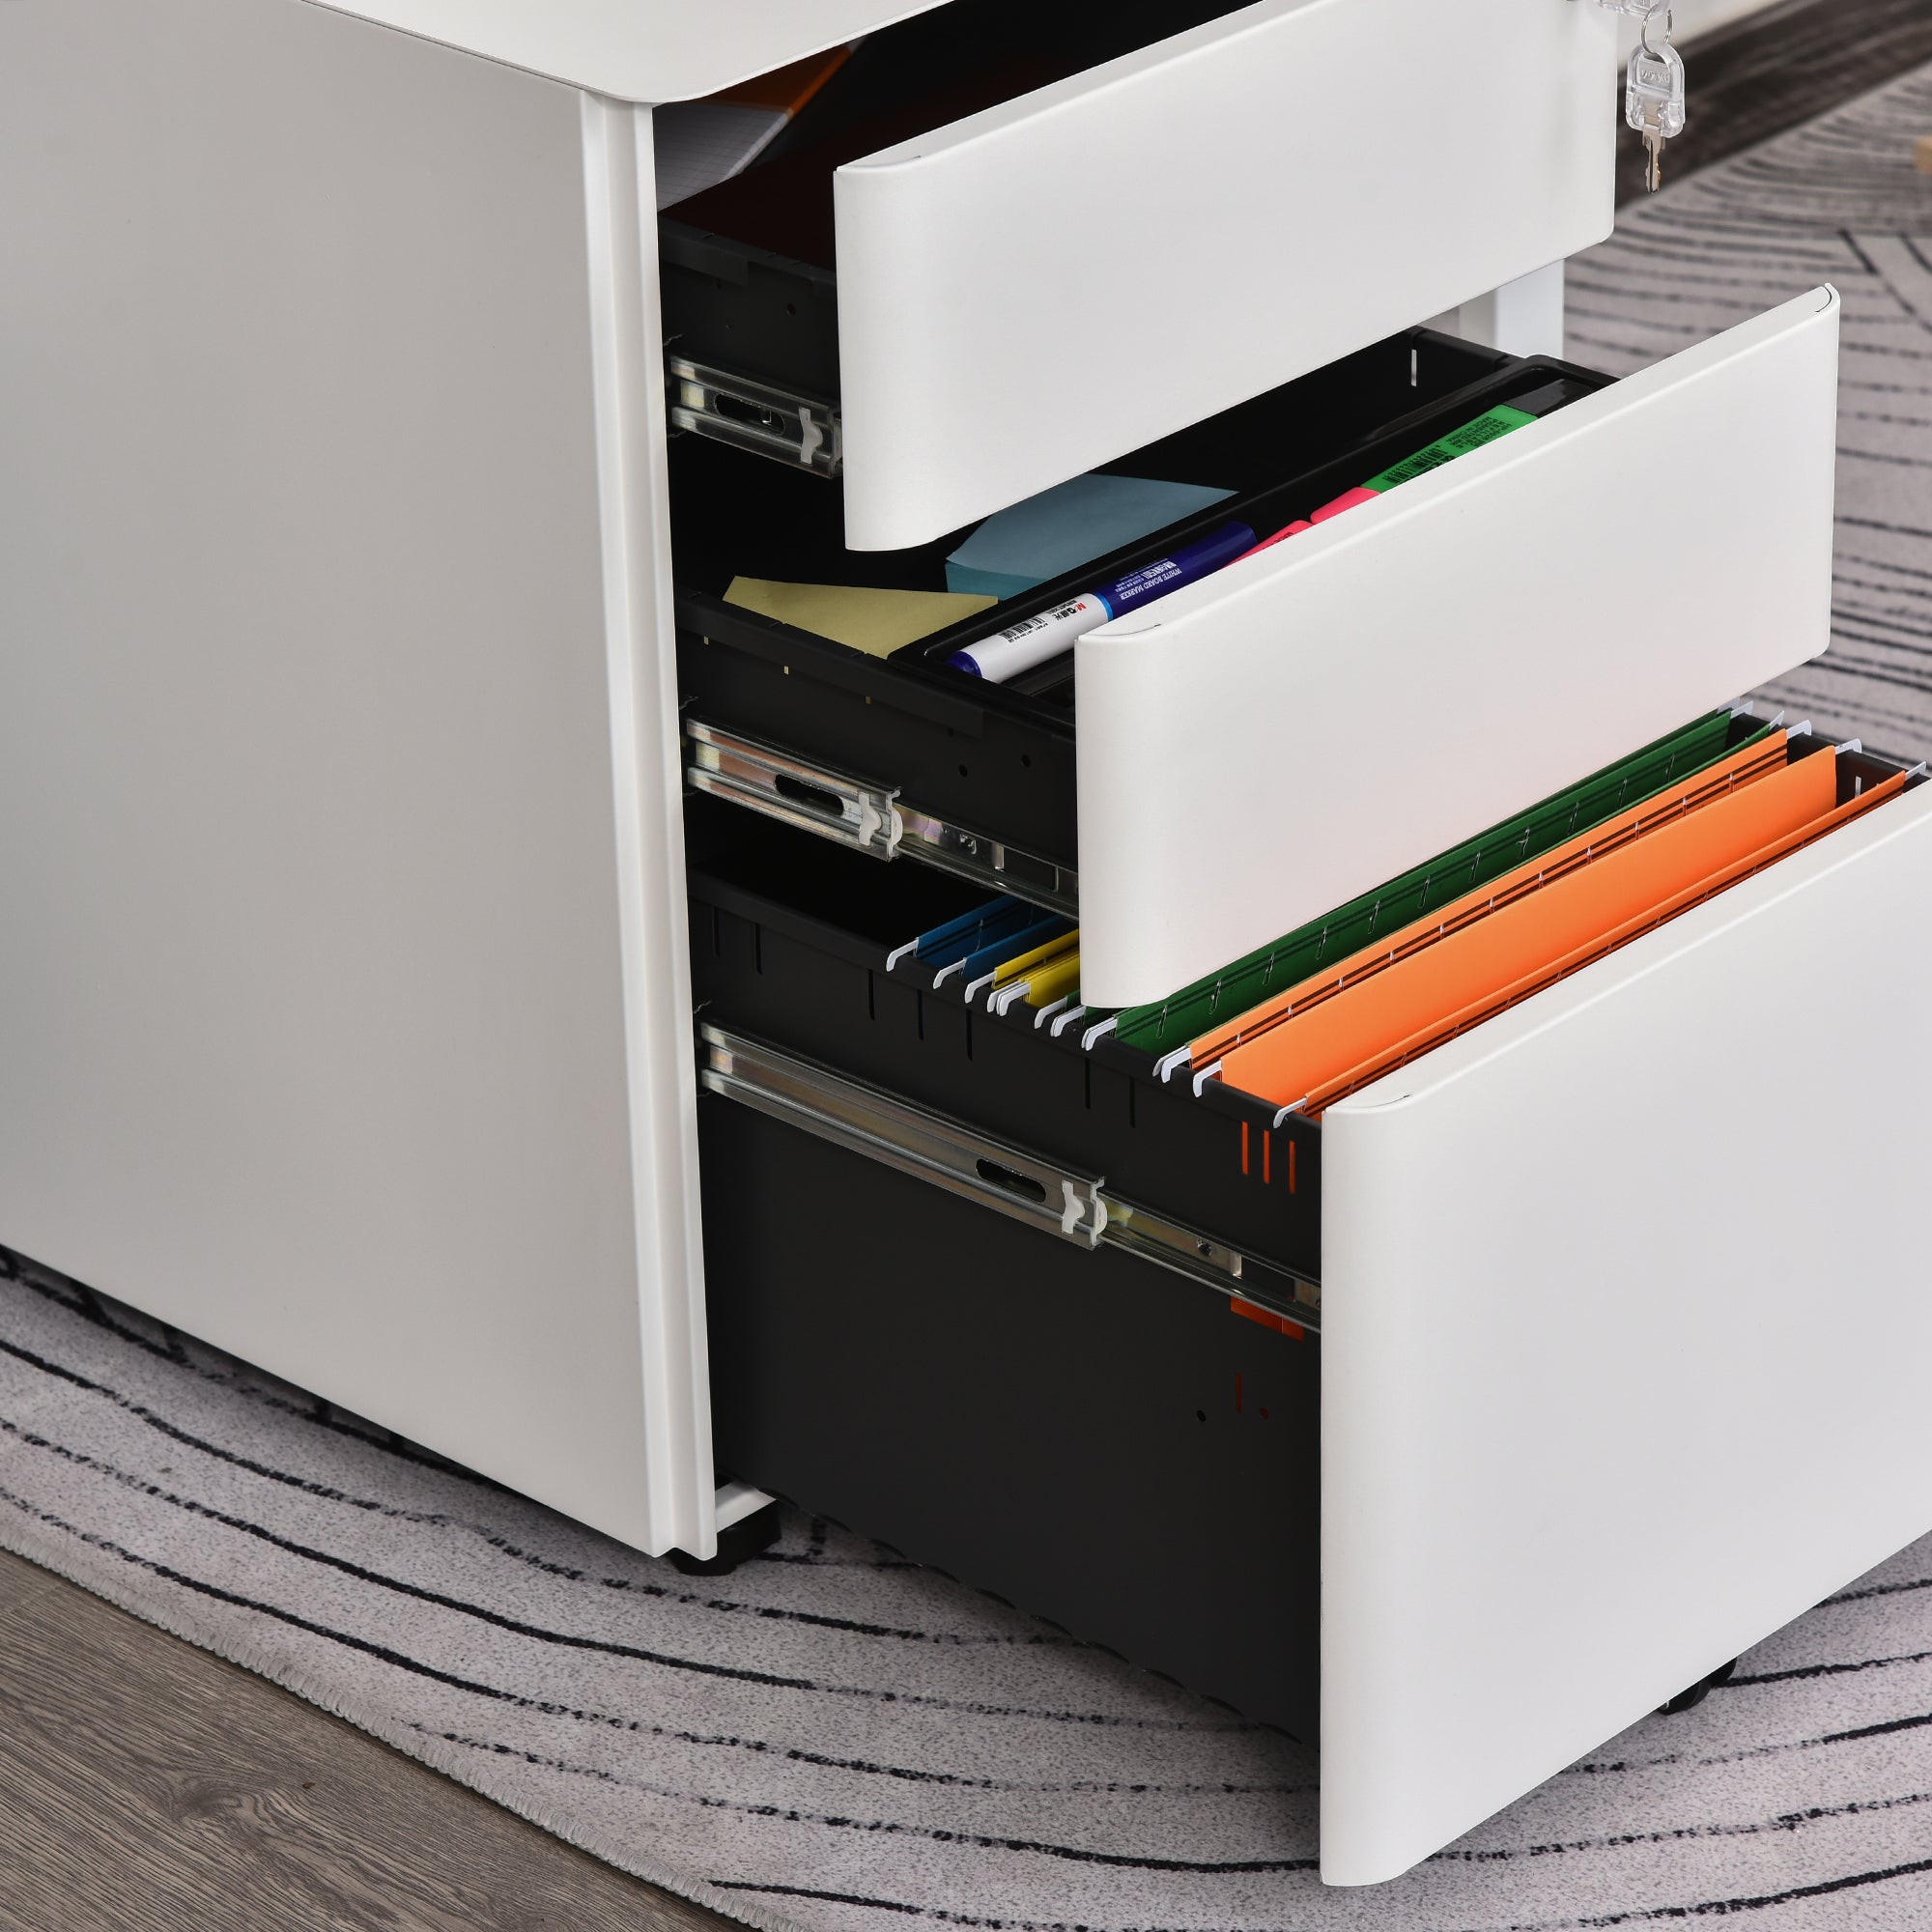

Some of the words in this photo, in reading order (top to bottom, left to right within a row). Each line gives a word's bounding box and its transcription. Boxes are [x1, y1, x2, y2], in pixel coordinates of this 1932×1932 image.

[1161, 567, 1182, 580] WHITE
[1142, 576, 1163, 588] BOARD
[1119, 584, 1144, 600] MARKER
